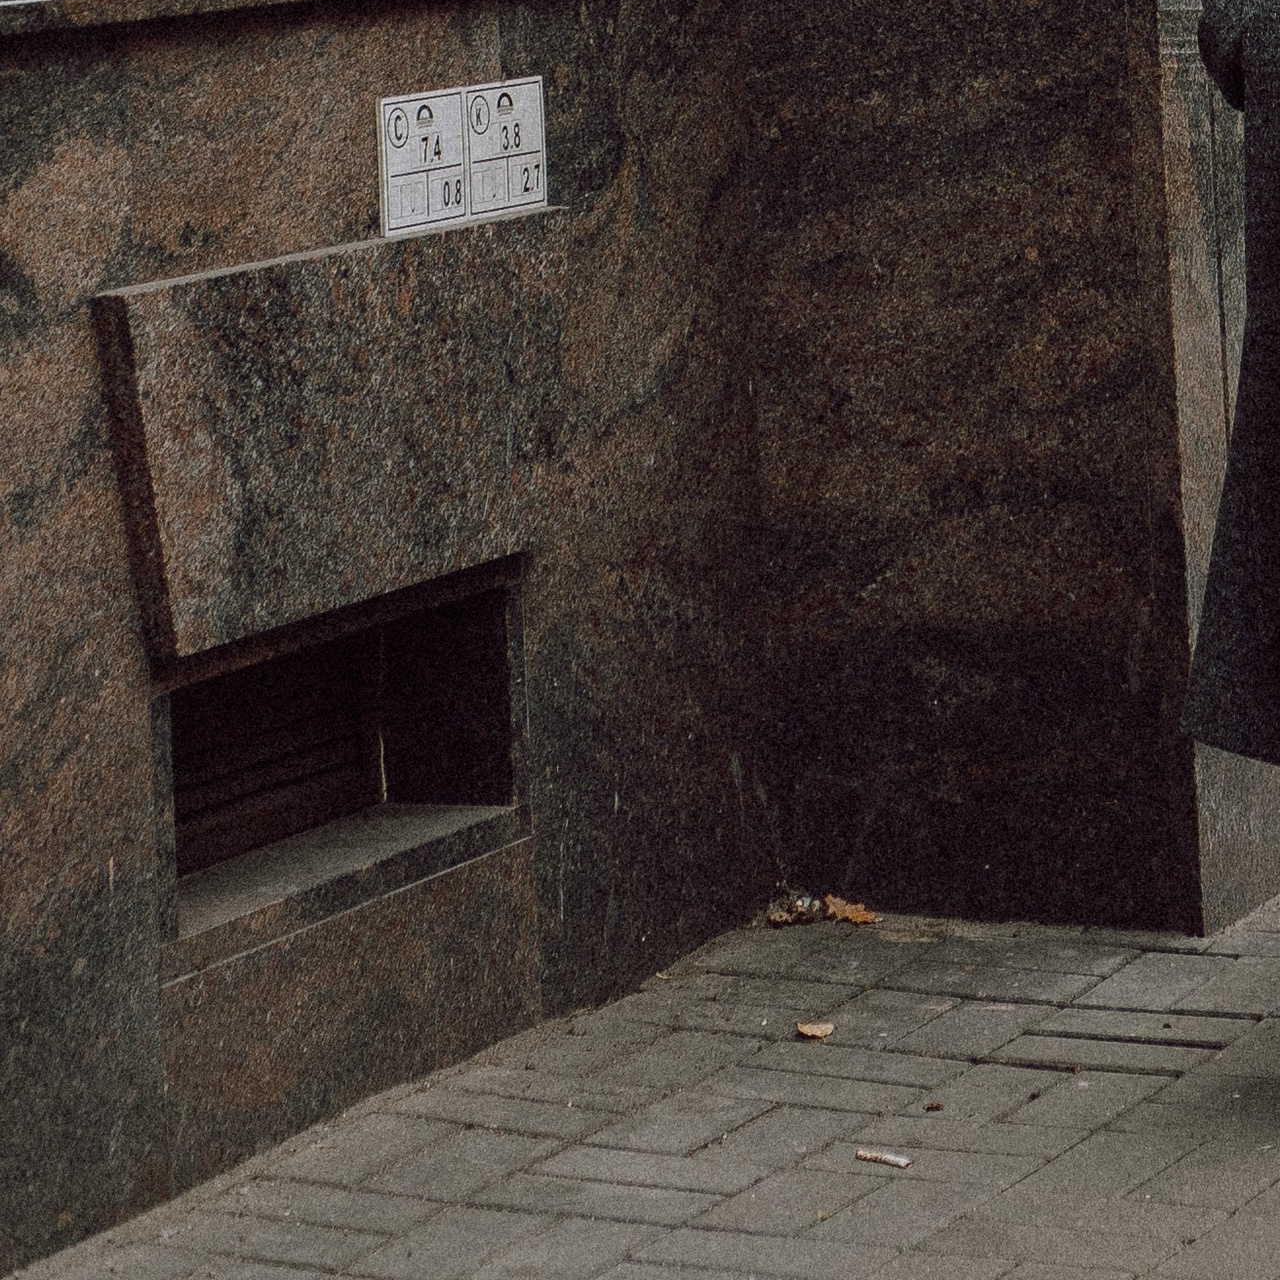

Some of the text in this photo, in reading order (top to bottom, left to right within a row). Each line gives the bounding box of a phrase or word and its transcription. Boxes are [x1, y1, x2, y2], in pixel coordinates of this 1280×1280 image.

[421, 134, 442, 163] 7.4
[501, 122, 521, 152] 3.8
[443, 178, 462, 208] 0.8
[522, 163, 541, 194] 2.7
